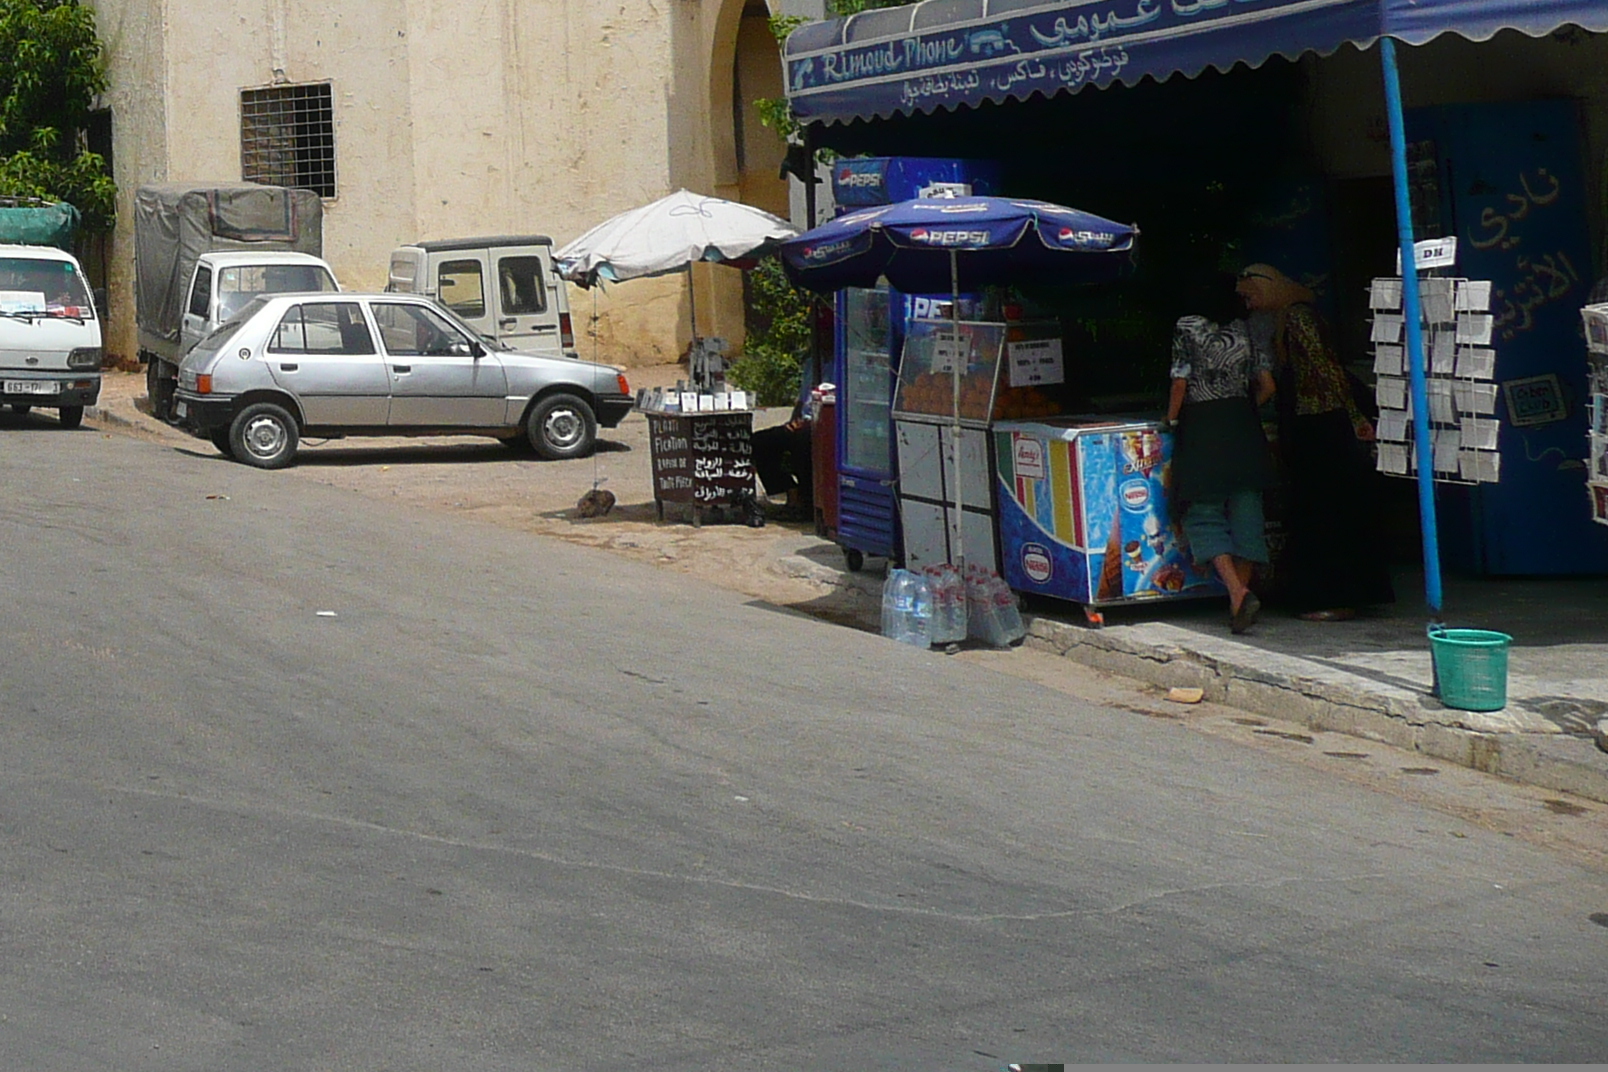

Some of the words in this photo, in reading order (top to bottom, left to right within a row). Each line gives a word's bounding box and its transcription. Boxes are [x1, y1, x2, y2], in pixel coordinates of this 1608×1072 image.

[902, 35, 965, 68] Phone
[850, 173, 881, 188] PEPSI
[1468, 168, 1559, 249] نادي
[928, 230, 990, 245] PEPSI
